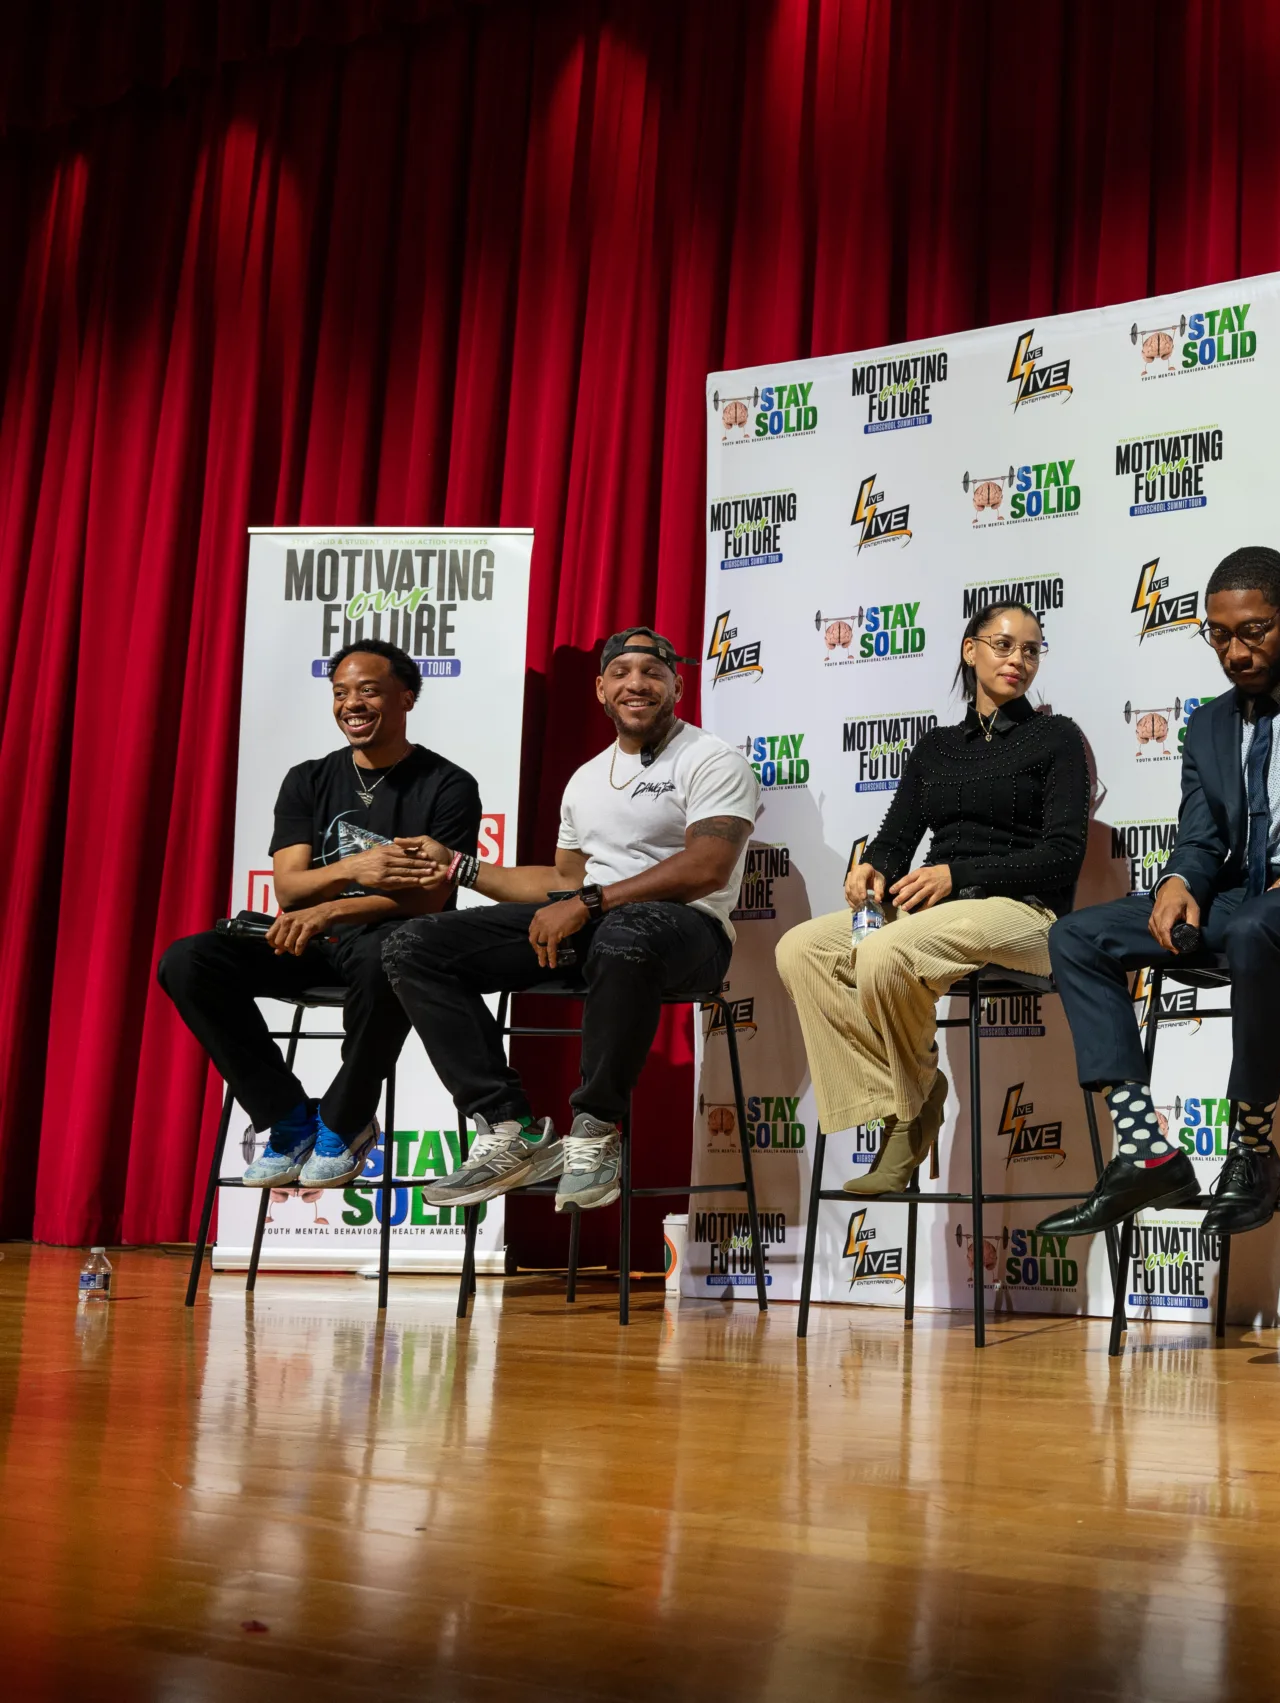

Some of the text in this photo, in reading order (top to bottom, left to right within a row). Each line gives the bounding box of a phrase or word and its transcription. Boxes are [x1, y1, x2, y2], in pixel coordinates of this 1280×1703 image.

[1188, 304, 1251, 340] STAY
[1182, 330, 1257, 368] SOLID
[852, 352, 947, 396] MOTIVATING
[761, 382, 813, 412] STAY
[869, 385, 930, 422] FUTURE
[880, 377, 920, 402] our
[1021, 391, 1062, 406] ENTERTAINMENT
[755, 406, 817, 437] SOLID
[868, 416, 928, 433] HIGHSCHOOL SUMMIT TOUR
[1116, 430, 1223, 475] MOTIVATING
[1017, 459, 1075, 492] STAY
[1147, 456, 1191, 481] our
[1135, 464, 1204, 504] FUTURE
[711, 493, 796, 532] MOTIVATING
[1010, 485, 1081, 519] SOLID
[1135, 498, 1201, 515] HIGHSCHOOL SUMMIT TOUR
[724, 524, 781, 559] FUTURE
[735, 517, 770, 539] our
[285, 549, 495, 601] MOTIVATING
[724, 555, 779, 569] HIGHSCHOOL SUMMIT TOUR
[347, 586, 433, 620] our
[865, 602, 920, 632] STAY
[322, 604, 457, 656] FUTURE
[859, 627, 925, 658] SOLID
[1147, 625, 1191, 638] ENTERTAINMENT
[428, 661, 452, 675] TOUR
[753, 733, 804, 761] STAY
[870, 739, 908, 760] our
[750, 759, 810, 787] SOLID
[860, 782, 887, 791] HIGHSCHOOL
[747, 1096, 799, 1123] STAY
[1011, 1229, 1069, 1258] STAY
[1006, 1258, 1078, 1286] SOLID
[1145, 1251, 1190, 1271] our
[1133, 1260, 1204, 1295] FUTURE
[1133, 1296, 1203, 1307] HIGHSCHOOL SUMMIT TOUR
